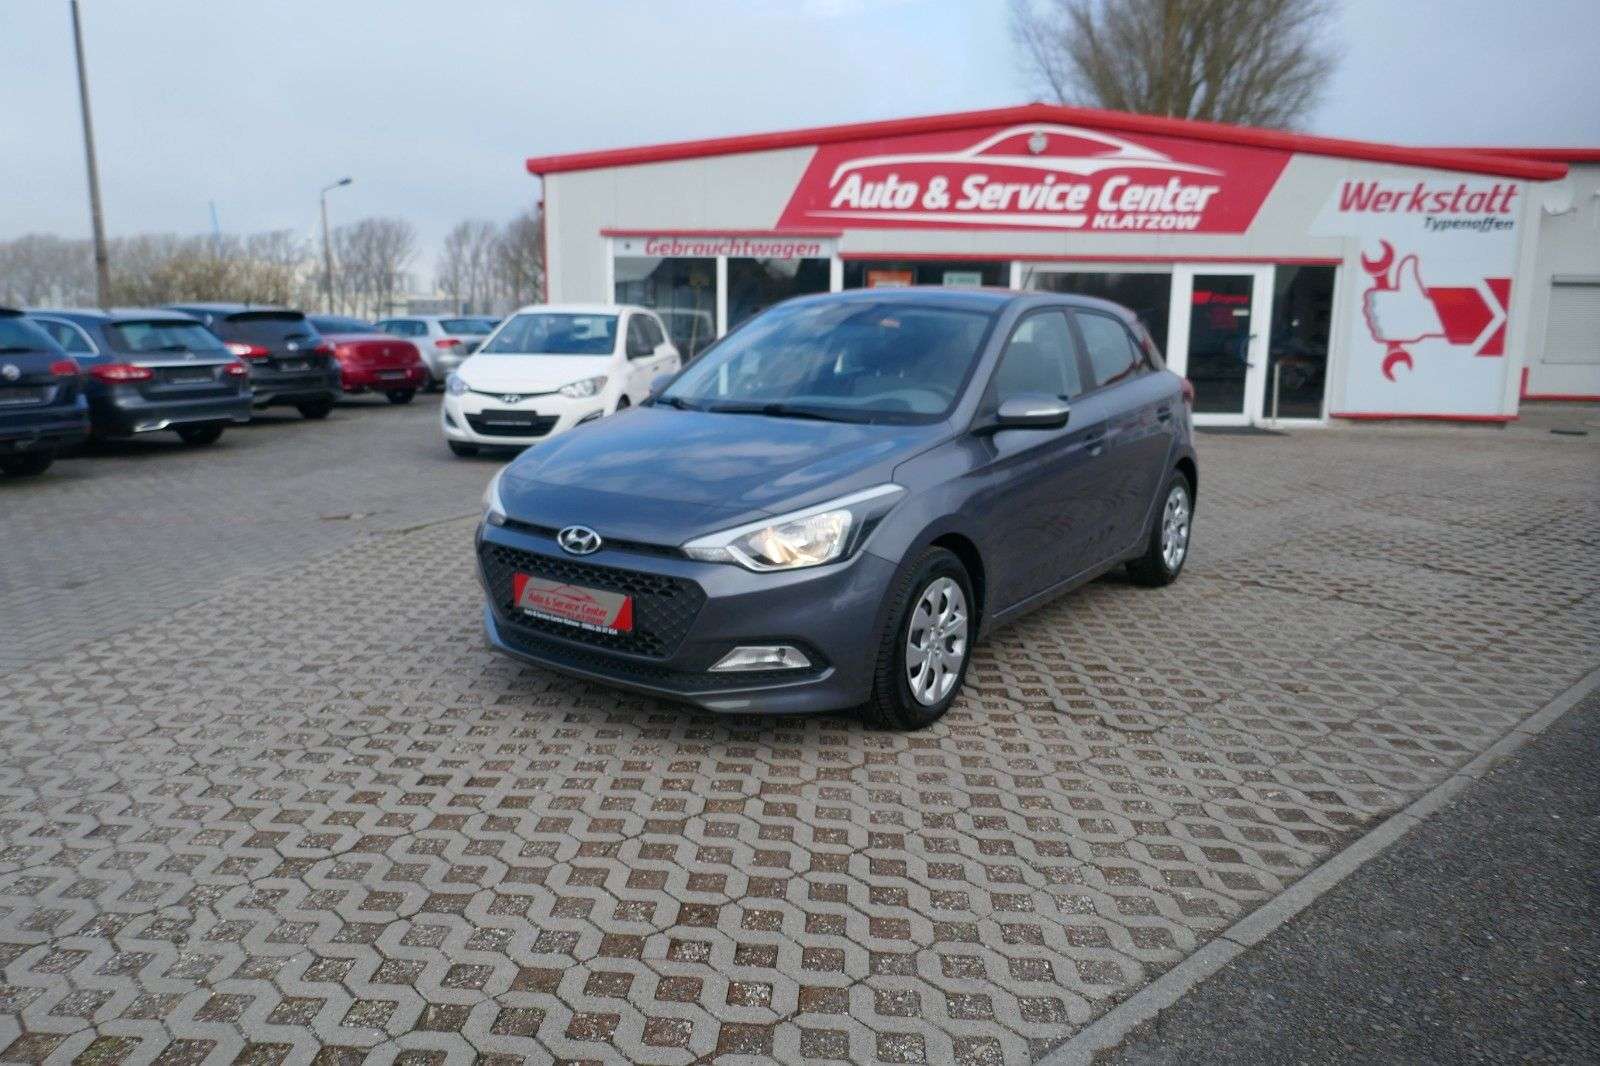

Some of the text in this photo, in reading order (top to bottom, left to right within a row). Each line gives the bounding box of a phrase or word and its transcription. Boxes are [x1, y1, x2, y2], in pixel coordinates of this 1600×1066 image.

[831, 174, 1221, 212] Auto & Service Center
[1338, 181, 1519, 214] Werkstatt
[1092, 213, 1201, 231] KLATZOW
[1424, 216, 1514, 232] Typenoffen
[645, 237, 821, 260] Gebrauchtwagen
